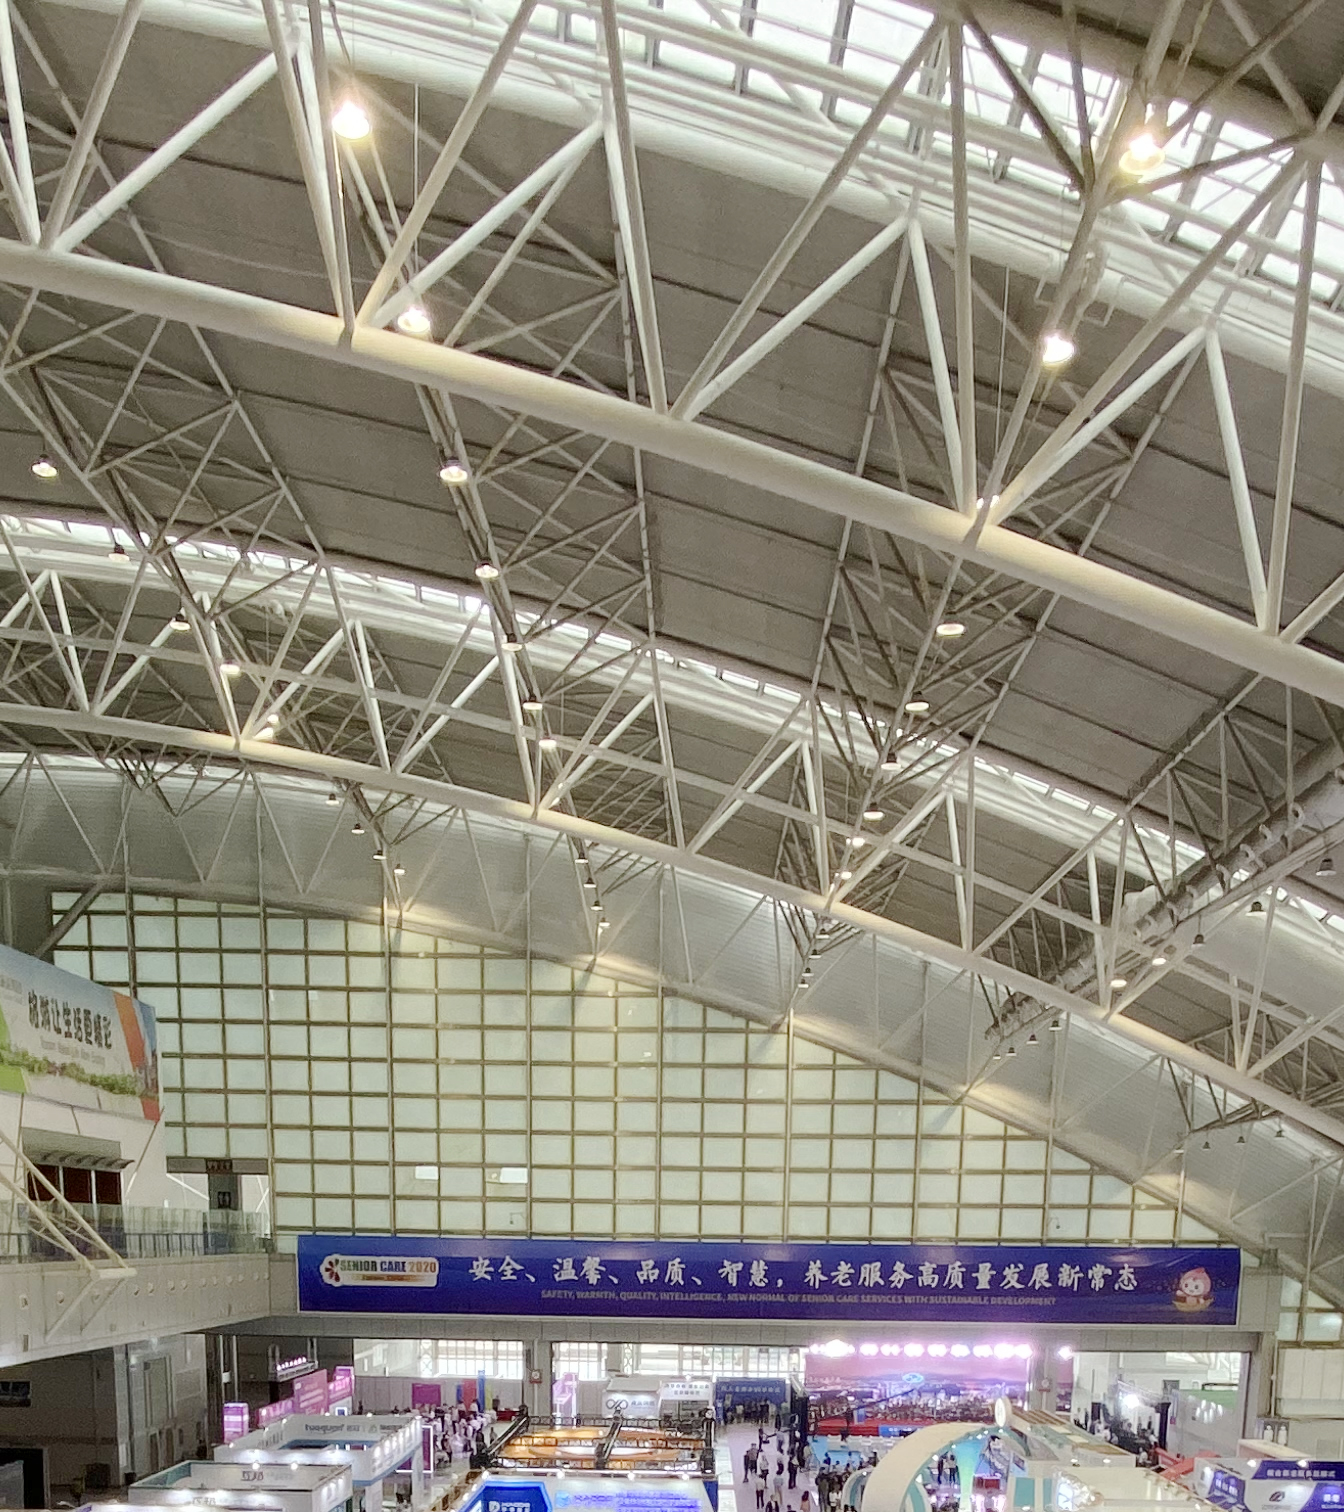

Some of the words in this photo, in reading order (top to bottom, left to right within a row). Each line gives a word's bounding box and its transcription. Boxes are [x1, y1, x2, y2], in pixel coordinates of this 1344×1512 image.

[340, 1260, 378, 1273] SENIOR
[380, 1260, 407, 1273] CARE
[408, 1261, 437, 1274] 2020
